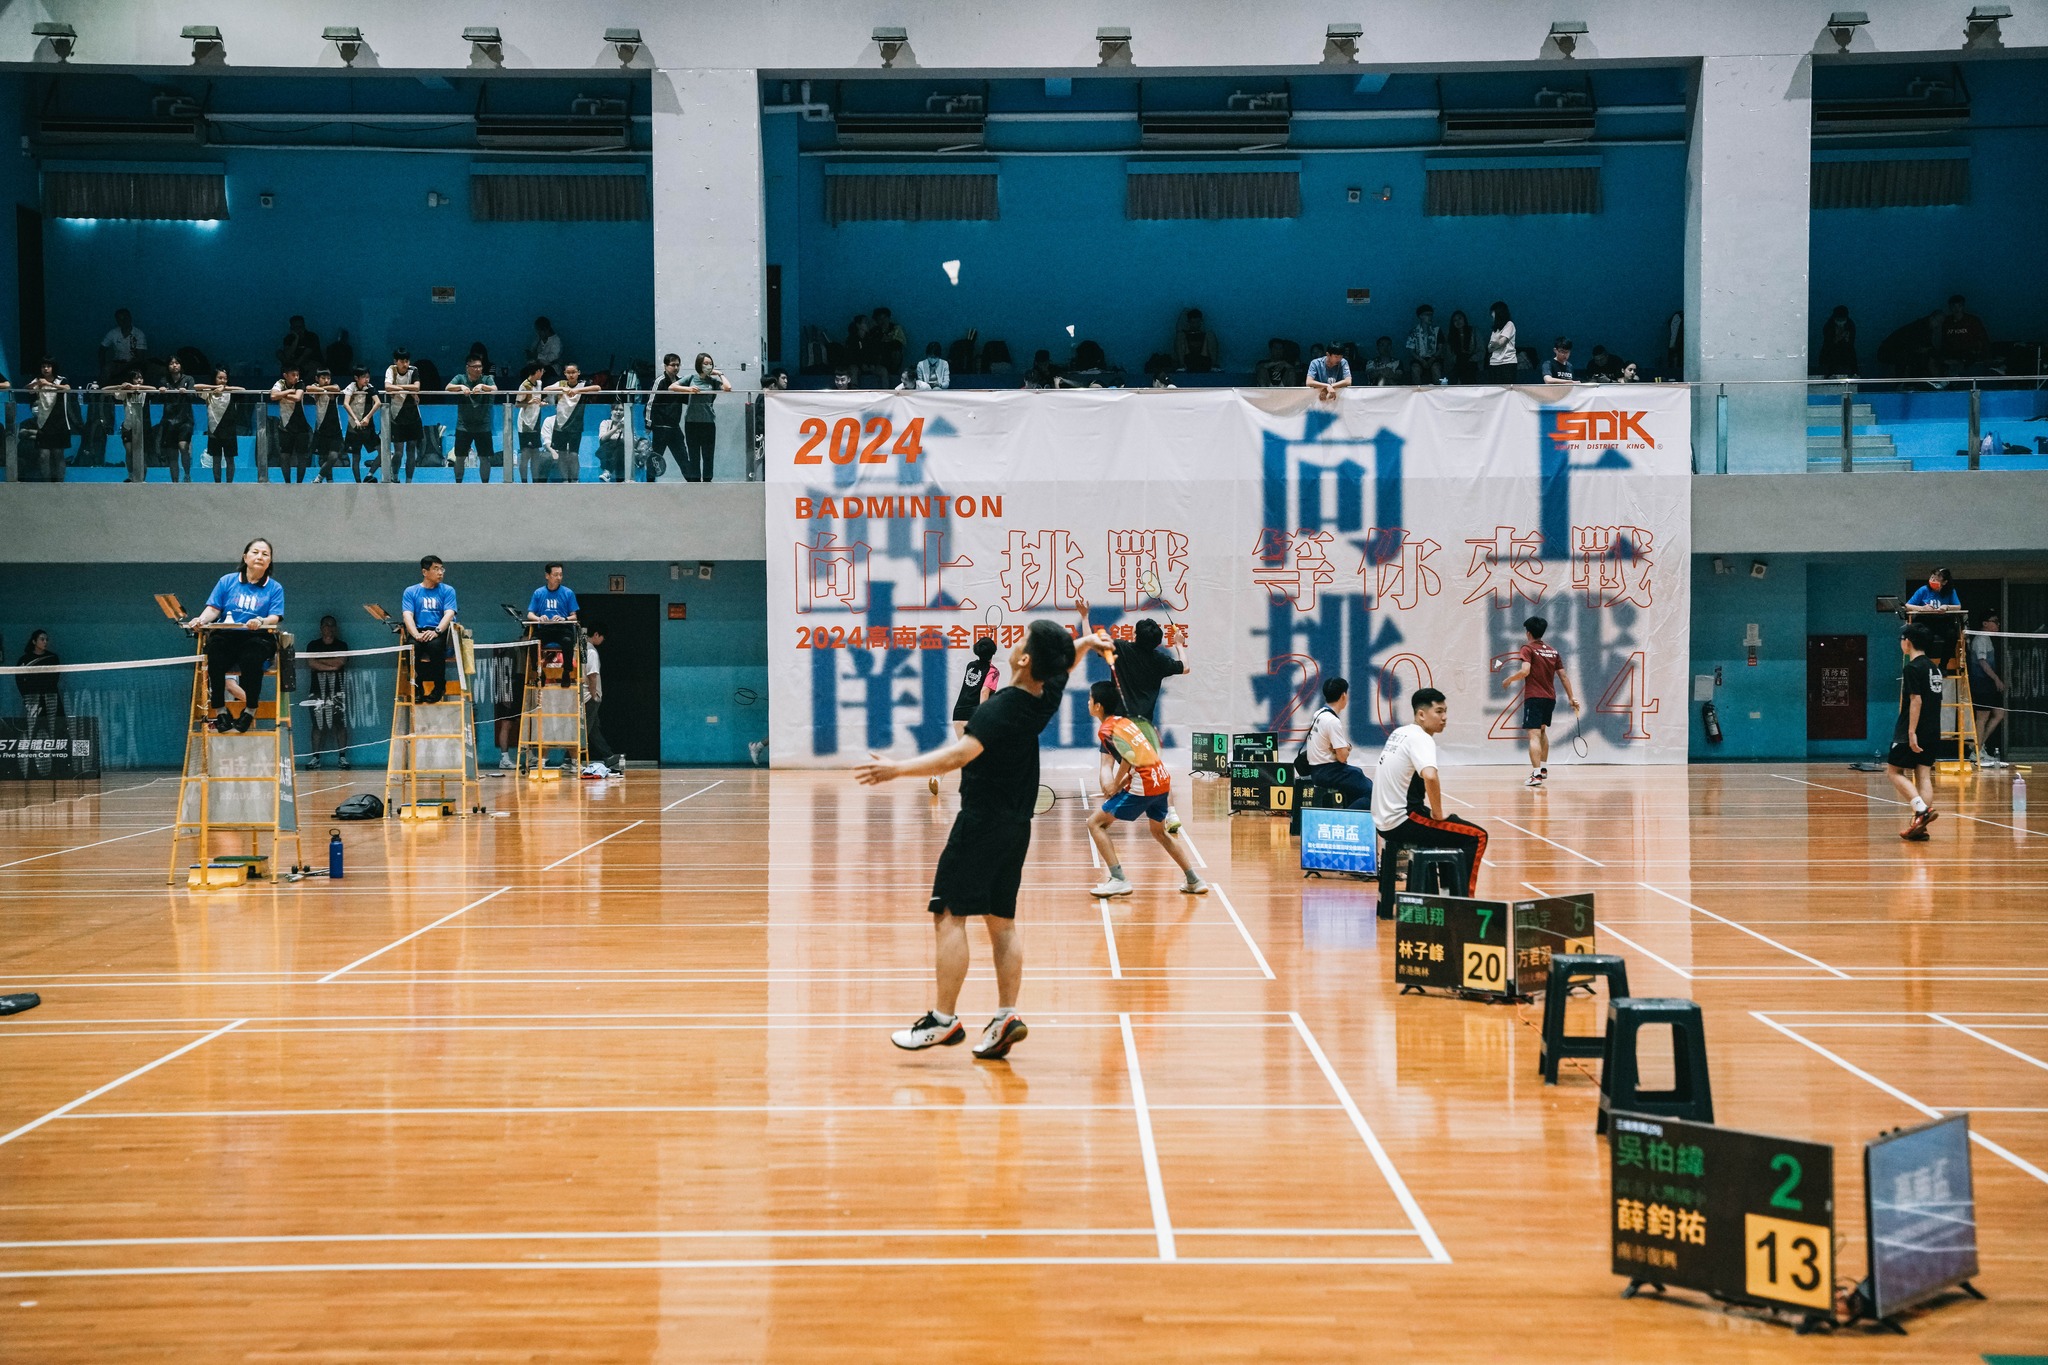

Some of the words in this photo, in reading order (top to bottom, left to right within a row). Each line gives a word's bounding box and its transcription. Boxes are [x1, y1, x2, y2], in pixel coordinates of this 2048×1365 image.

[794, 418, 925, 465] 2024
[1548, 410, 1655, 449] SDK
[796, 495, 1003, 519] BADMINTON
[795, 529, 1190, 614] 向上挑戰
[1252, 526, 1654, 612] 等你來戰
[1217, 737, 1223, 751] 8
[1266, 736, 1273, 749] 5
[1215, 754, 1226, 769] 16
[1276, 767, 1286, 784] 0
[1277, 790, 1286, 806] 0
[1318, 824, 1359, 842] 高南盃
[1476, 909, 1493, 939] 7
[1574, 903, 1586, 931] 5
[1398, 940, 1445, 963] 林子峰
[1468, 951, 1501, 983] 20
[1770, 1153, 1803, 1211] 2
[1757, 1231, 1821, 1291] 13
